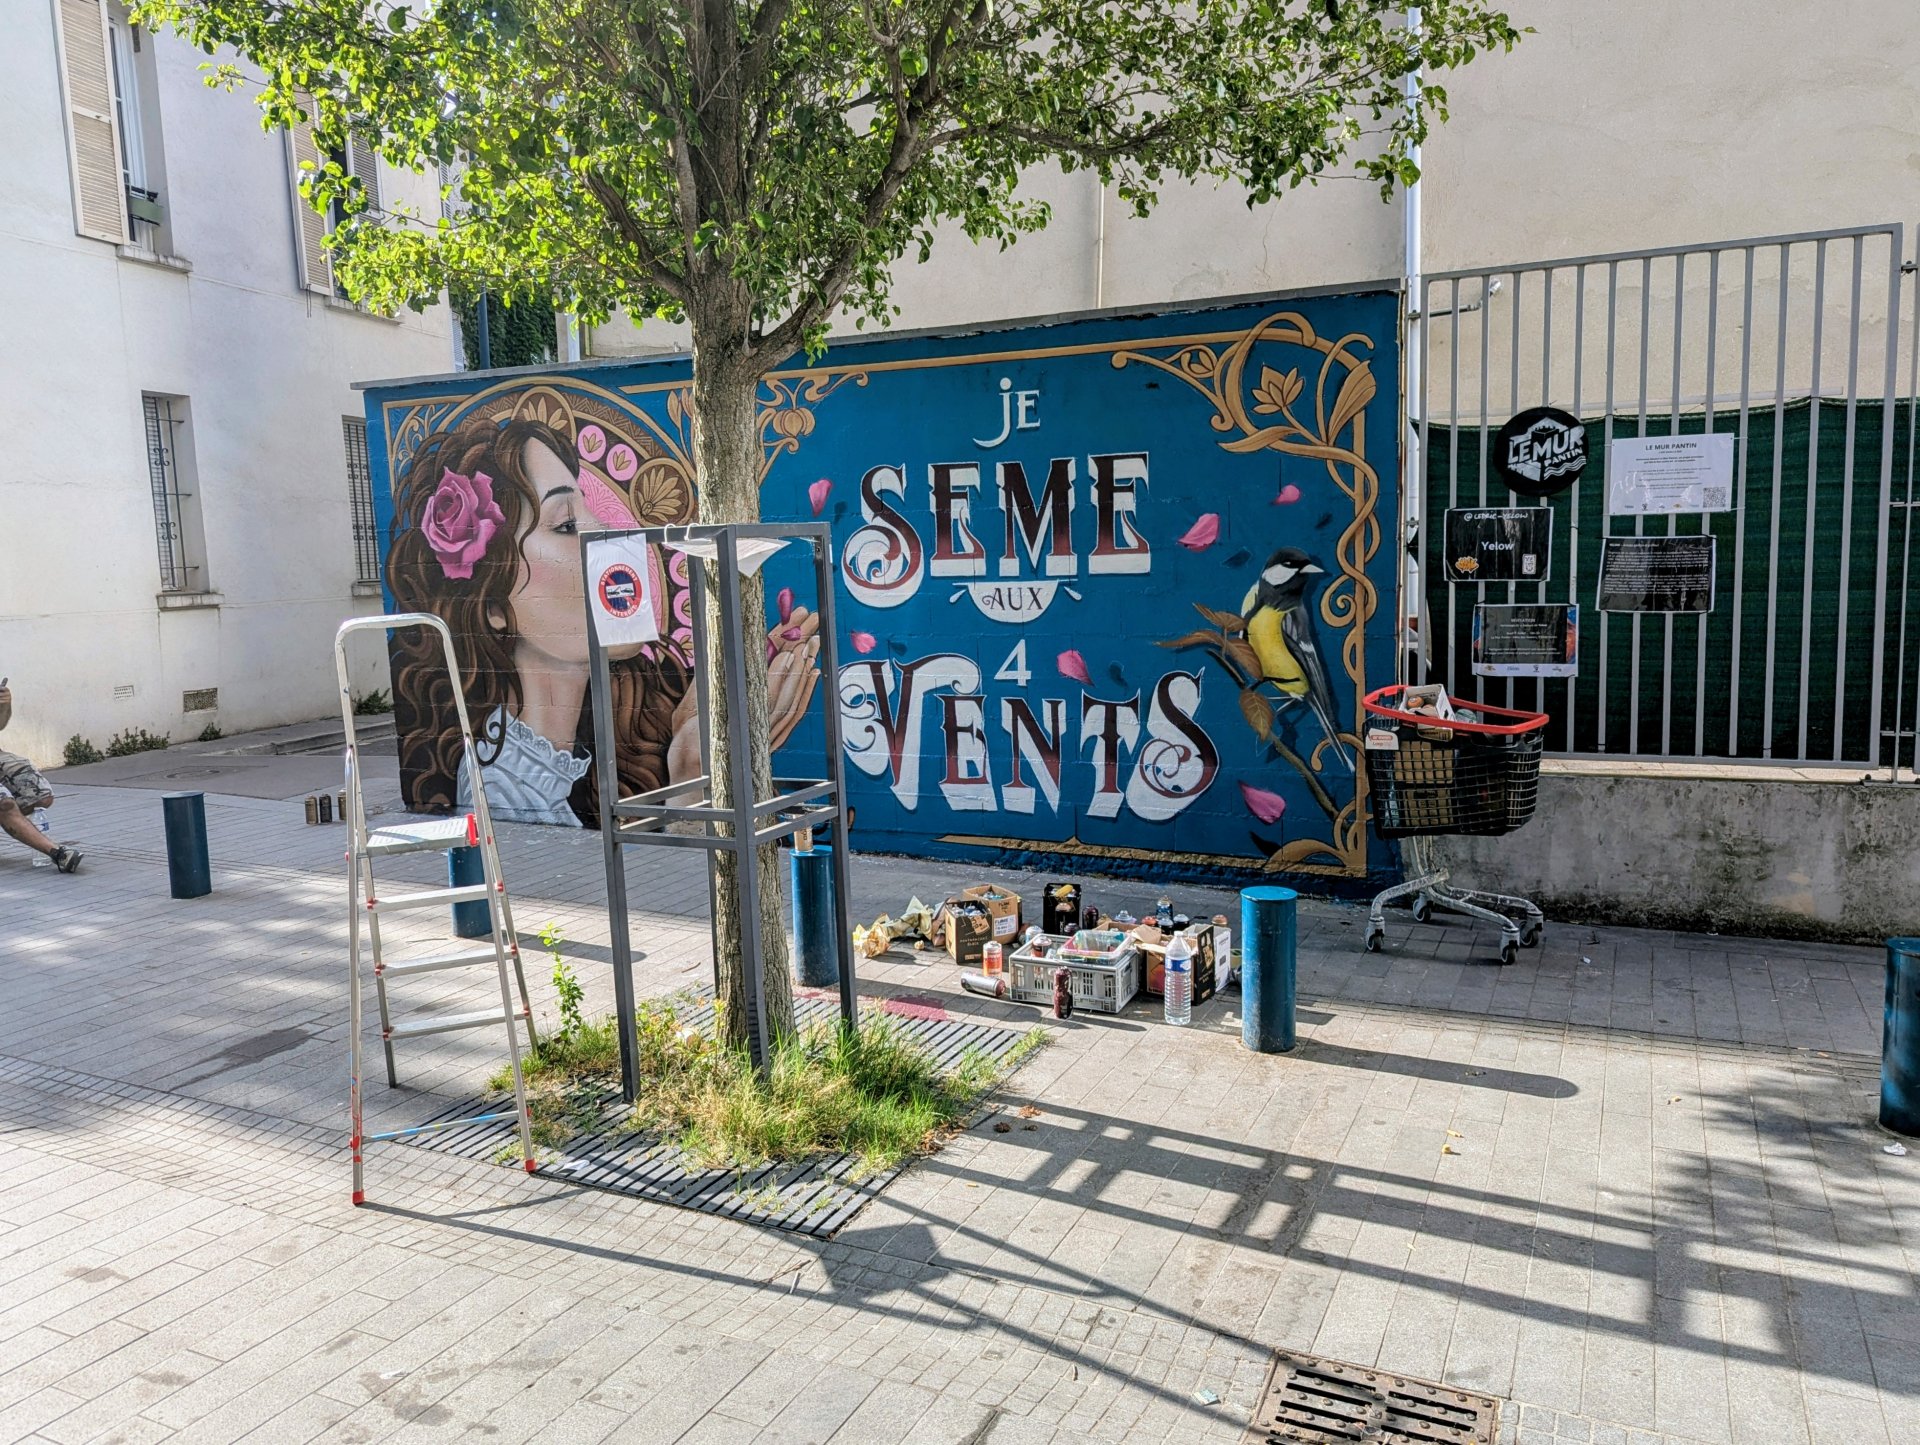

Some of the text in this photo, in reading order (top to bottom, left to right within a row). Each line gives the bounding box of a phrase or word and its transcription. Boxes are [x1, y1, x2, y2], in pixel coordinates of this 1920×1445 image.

[1507, 425, 1585, 464] LE MUR
[1543, 447, 1584, 467] PANTIN
[841, 452, 1152, 608] SEME
[1481, 541, 1515, 551] Yelow
[600, 565, 638, 586] STATIONNEMENT
[981, 585, 1045, 612] AUX
[994, 638, 1033, 687] 4
[838, 653, 1221, 821] VENTS
